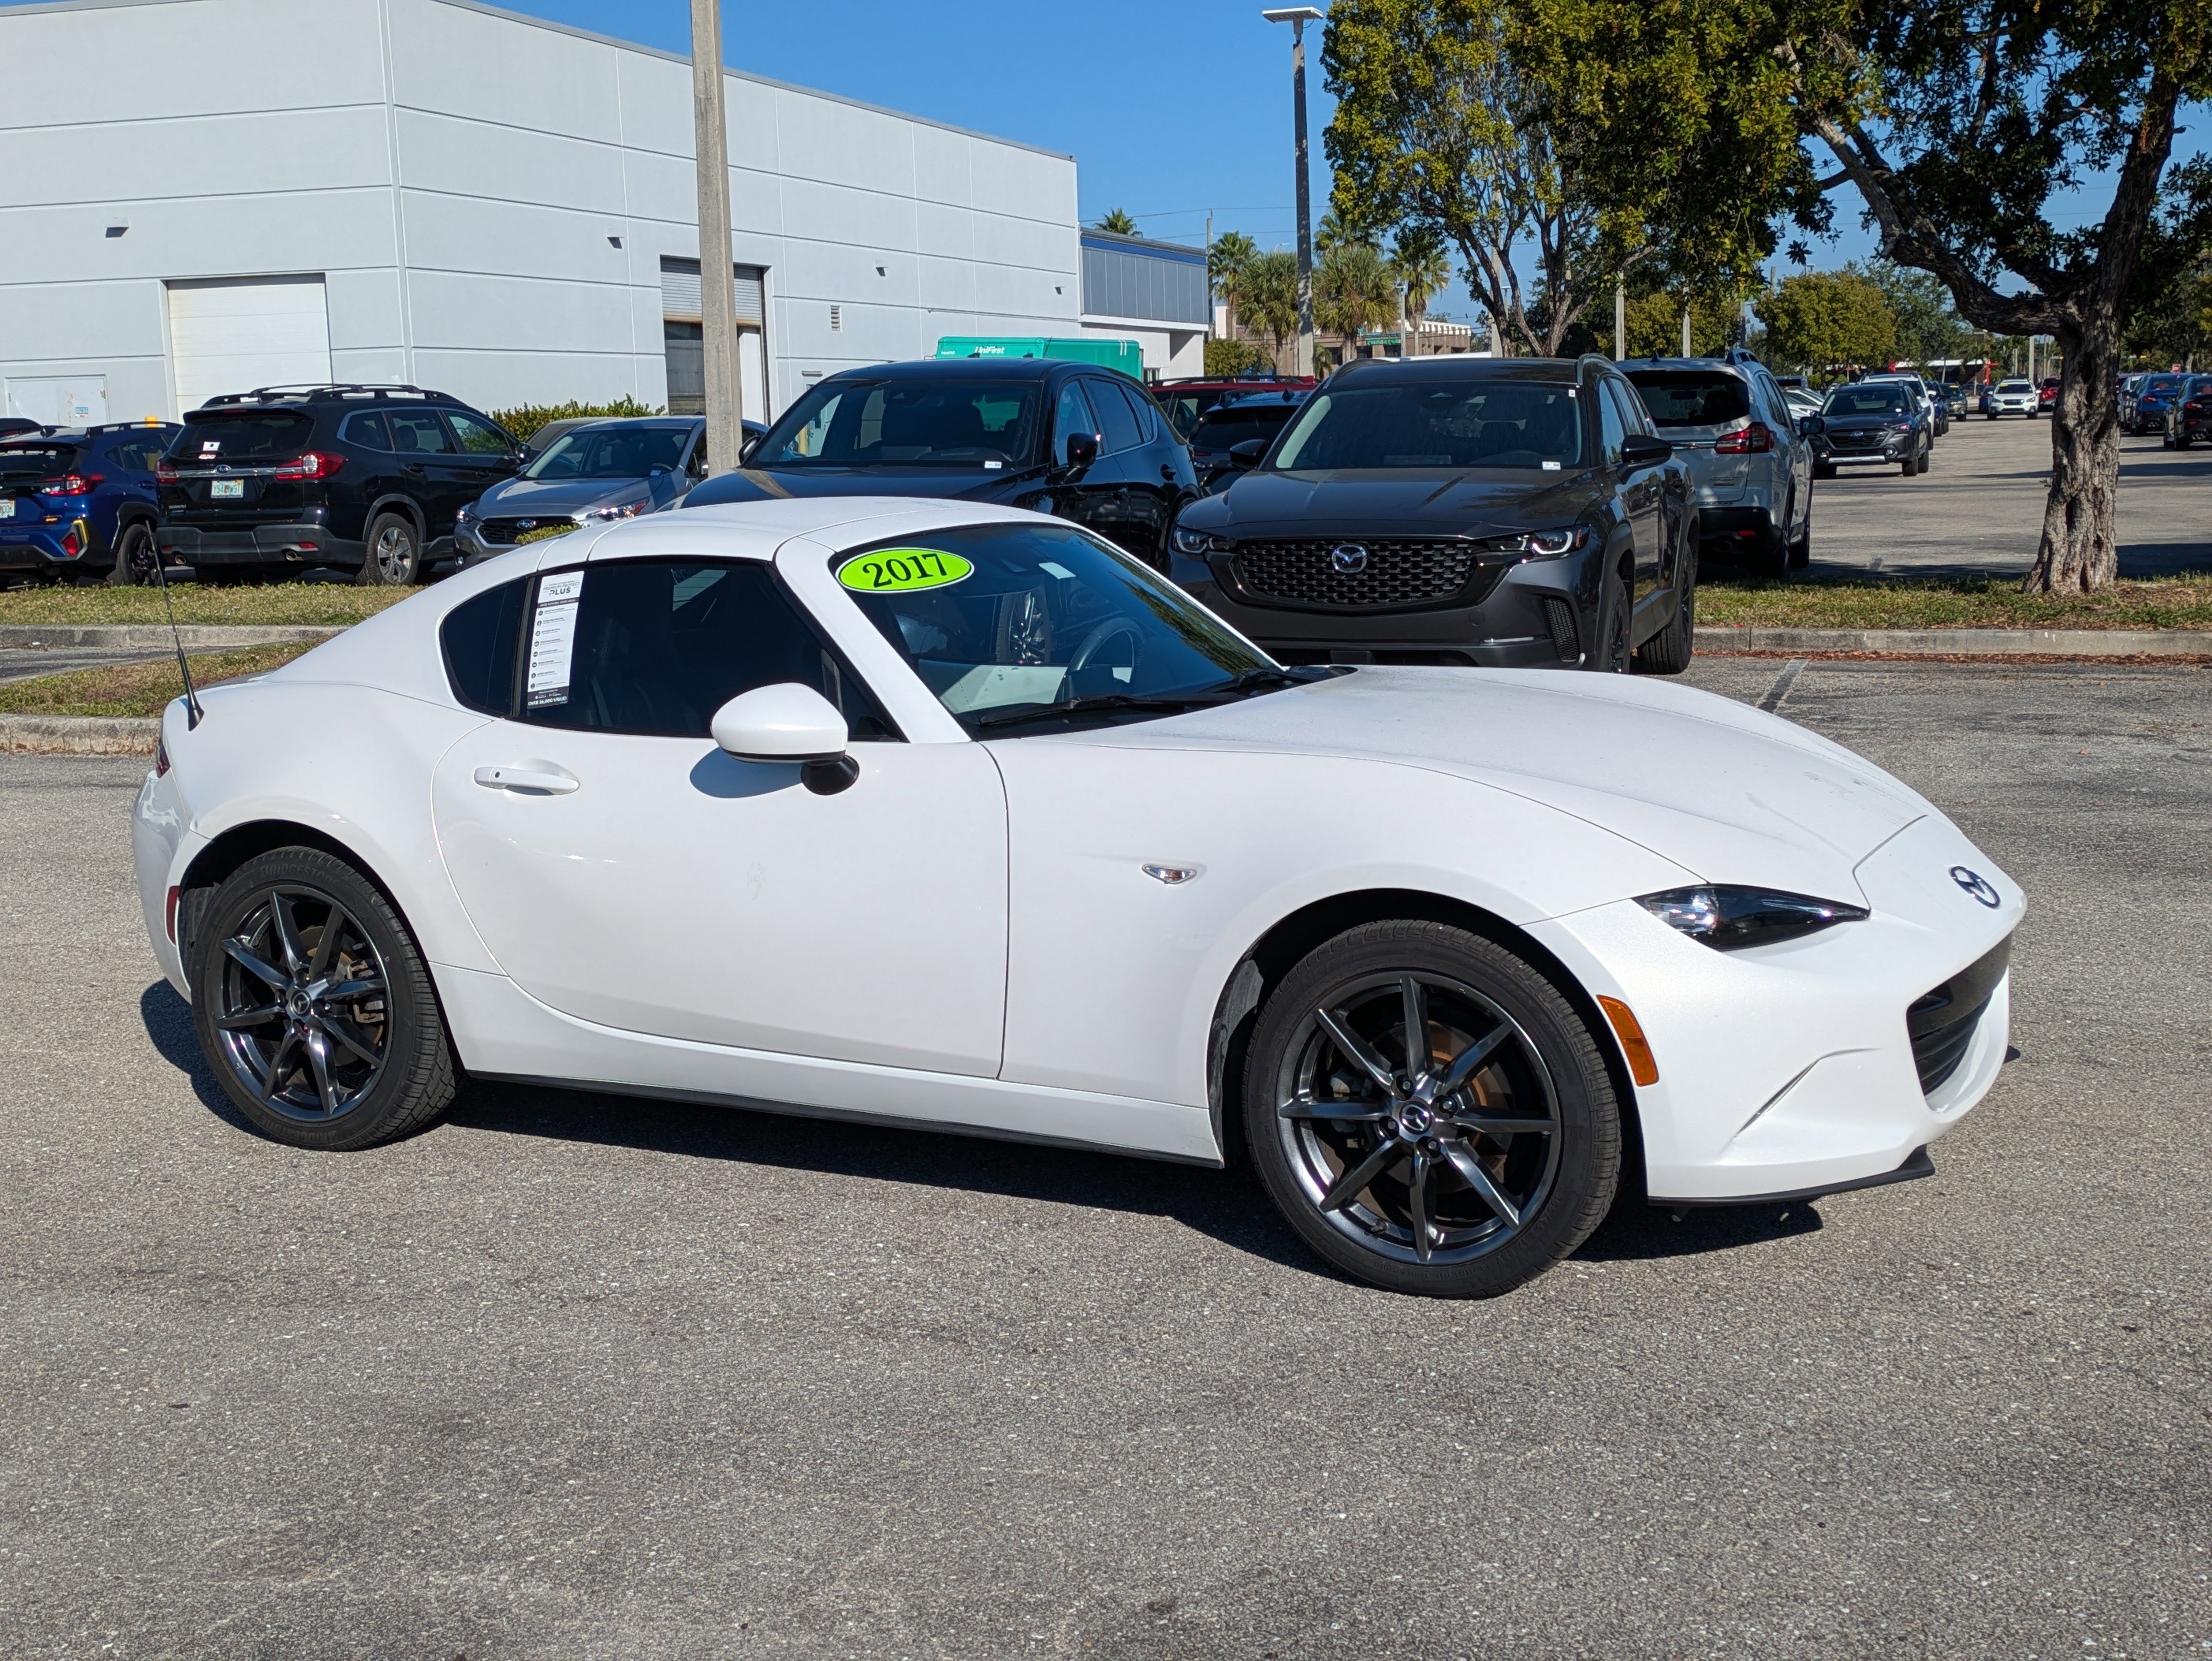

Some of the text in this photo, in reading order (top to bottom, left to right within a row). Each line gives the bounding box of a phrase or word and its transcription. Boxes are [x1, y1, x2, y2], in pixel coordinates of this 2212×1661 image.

[974, 345, 1005, 354] UniFirst
[862, 553, 948, 588] 2017
[549, 587, 571, 596] PLUS
